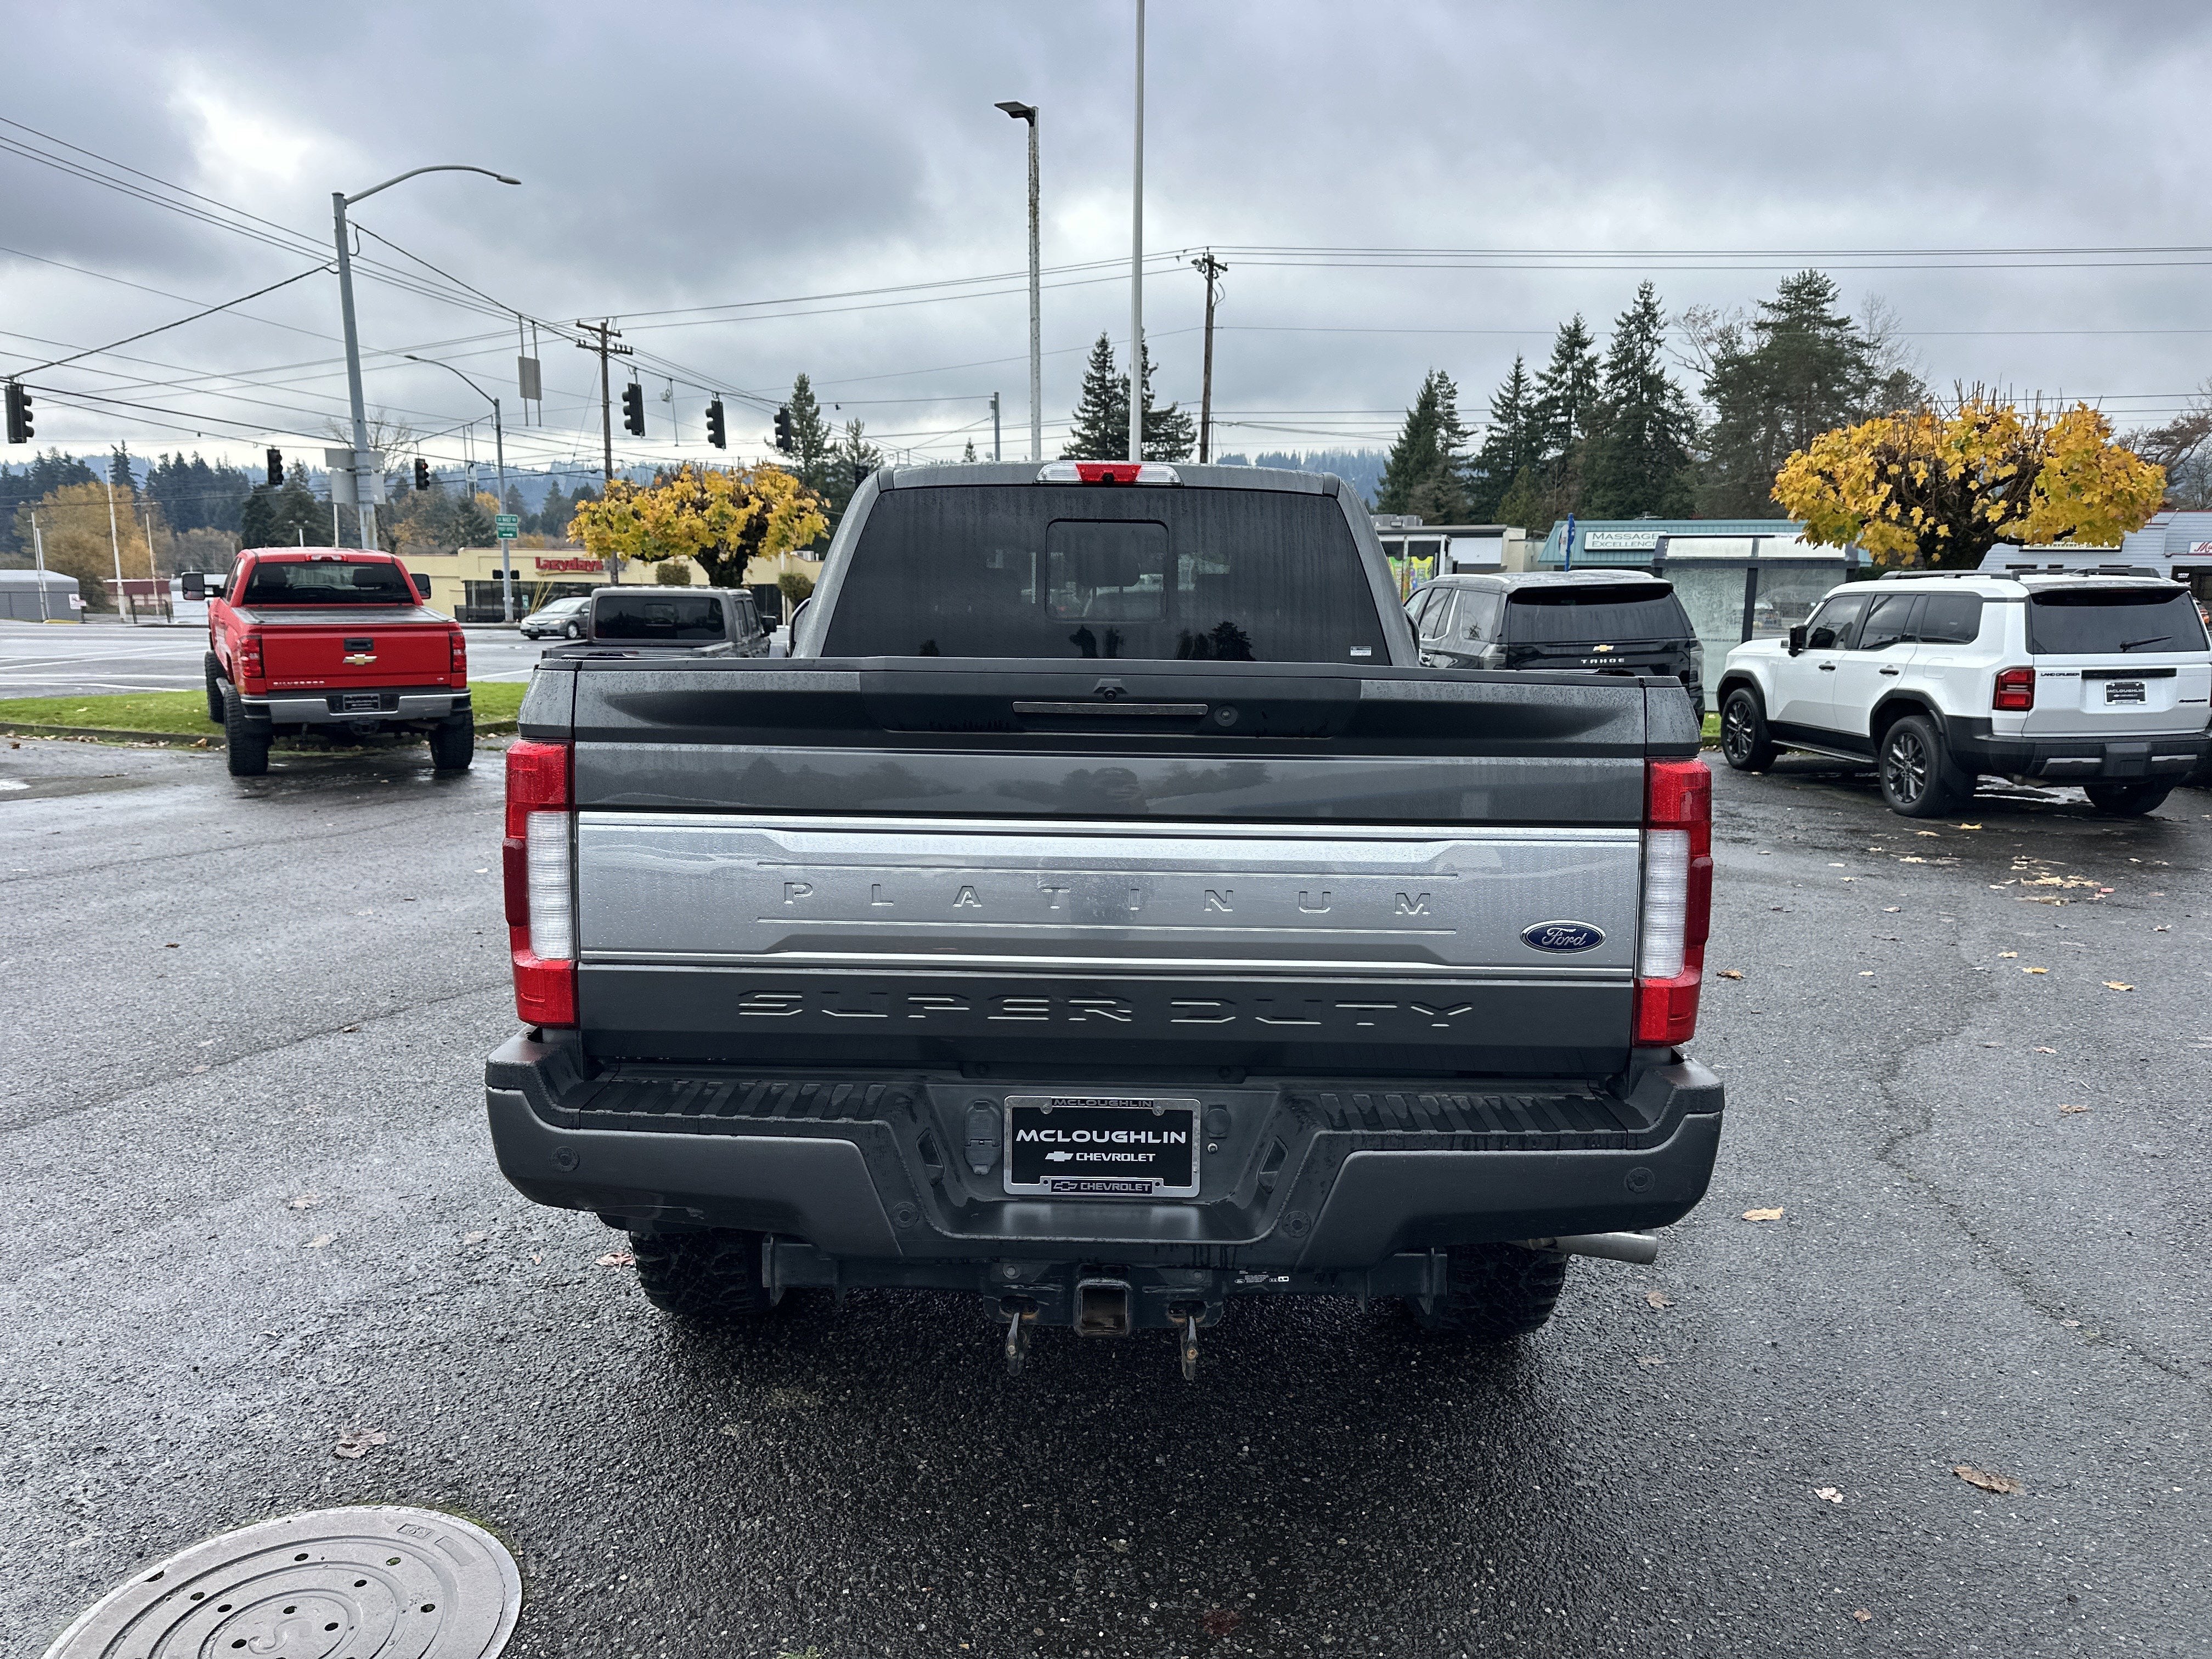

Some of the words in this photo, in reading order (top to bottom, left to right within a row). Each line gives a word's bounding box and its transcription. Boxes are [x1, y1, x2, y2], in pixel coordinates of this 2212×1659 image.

[535, 556, 604, 572] Lazydays
[783, 882, 1431, 915] PLATINUM
[1541, 927, 1588, 946] Ford
[738, 989, 1132, 1022] SUPER
[1170, 997, 1474, 1027] DUTY
[1053, 1099, 1152, 1108] MCLOUGHLIN
[1015, 1129, 1187, 1144] MCLOUGHLIN
[1076, 1152, 1156, 1162] CHEVROLET
[1080, 1182, 1151, 1192] CHEVROLET
